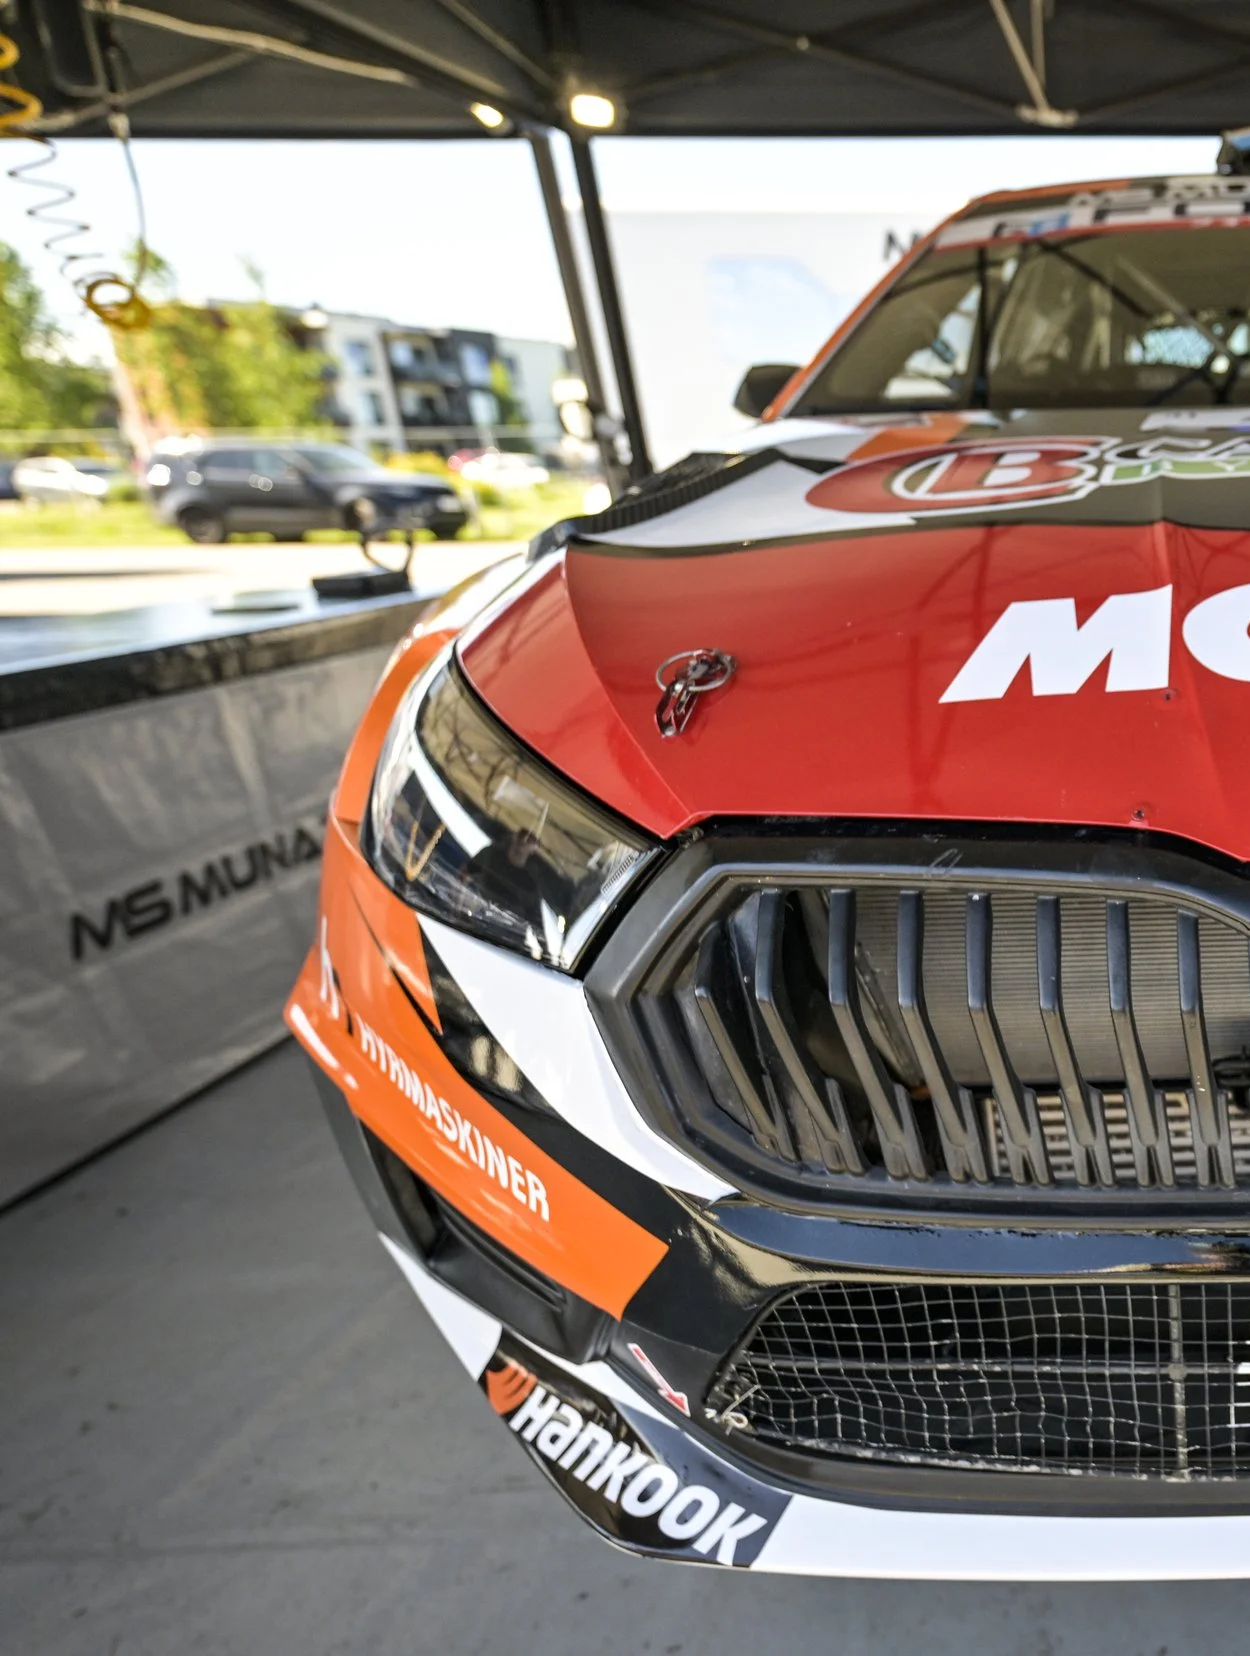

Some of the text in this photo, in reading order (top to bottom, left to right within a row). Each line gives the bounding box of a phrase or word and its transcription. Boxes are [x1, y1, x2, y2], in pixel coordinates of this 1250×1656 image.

[68, 816, 326, 963] MS MUNA
[354, 1012, 550, 1222] HYRMASKINER
